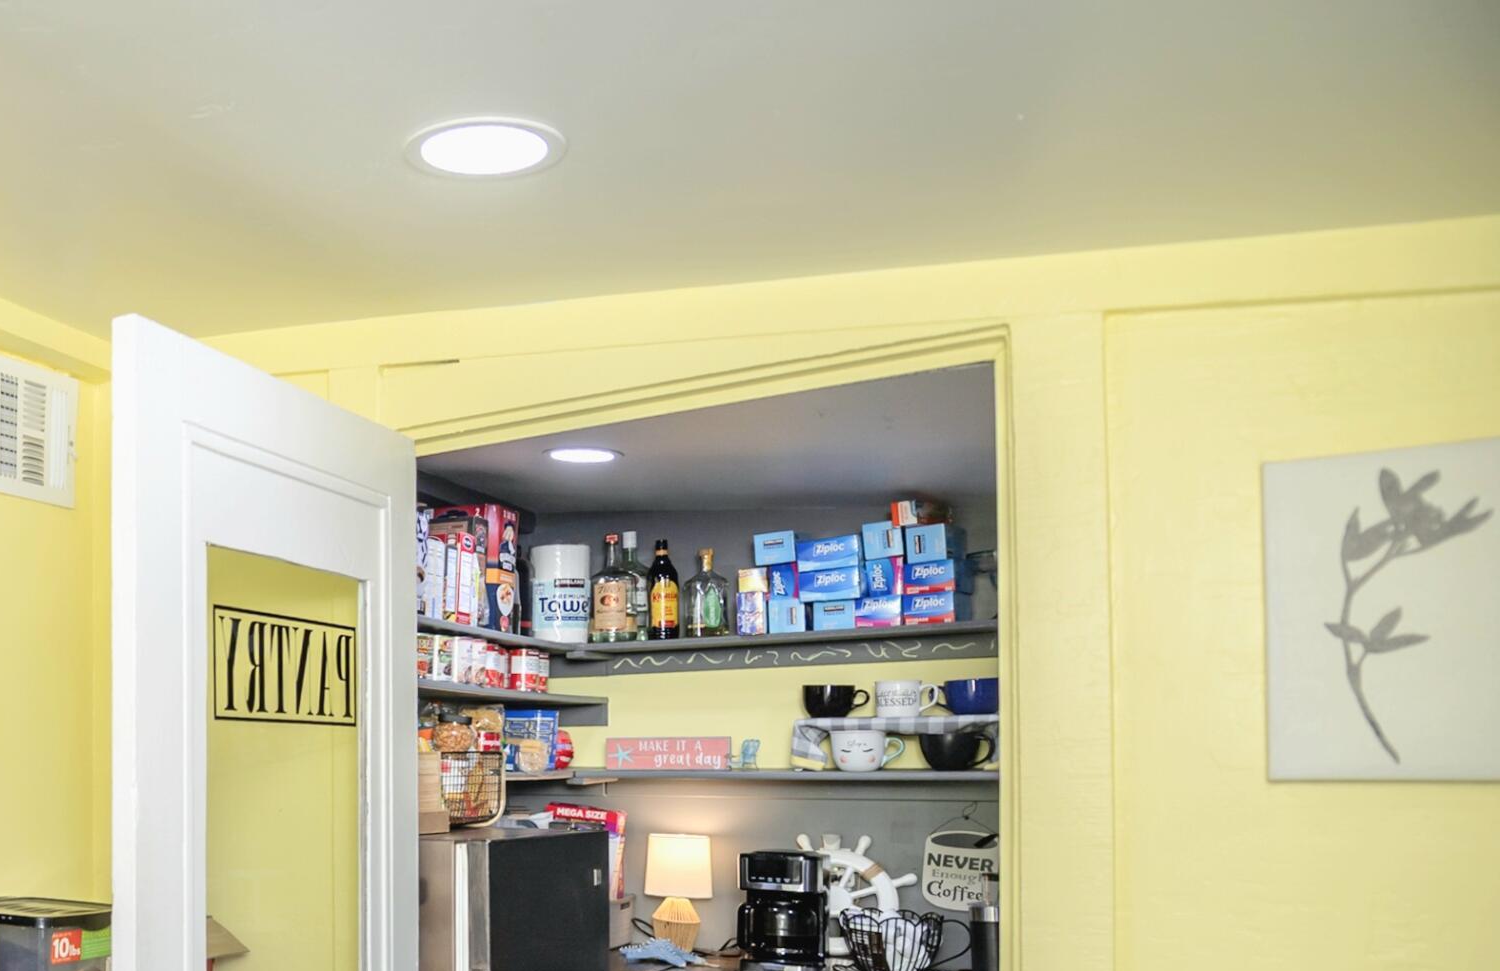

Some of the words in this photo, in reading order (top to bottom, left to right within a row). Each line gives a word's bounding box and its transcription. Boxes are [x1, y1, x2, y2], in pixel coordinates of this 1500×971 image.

[815, 542, 844, 555] Ziploc
[873, 564, 886, 589] Ziploc
[915, 565, 944, 578] Ziploc
[772, 571, 786, 596] Ziploc
[817, 574, 846, 587] Ziploc
[864, 598, 891, 611] Ziplo
[915, 597, 945, 610] Ziploc
[639, 740, 669, 752] MAKE
[676, 740, 687, 752] IT
[695, 740, 703, 752] A
[654, 752, 691, 768] great
[695, 752, 722, 770] day
[556, 807, 584, 818] MEGA
[585, 810, 607, 820] SIZE
[926, 852, 994, 872] NEVER
[927, 880, 984, 901] Coffee
